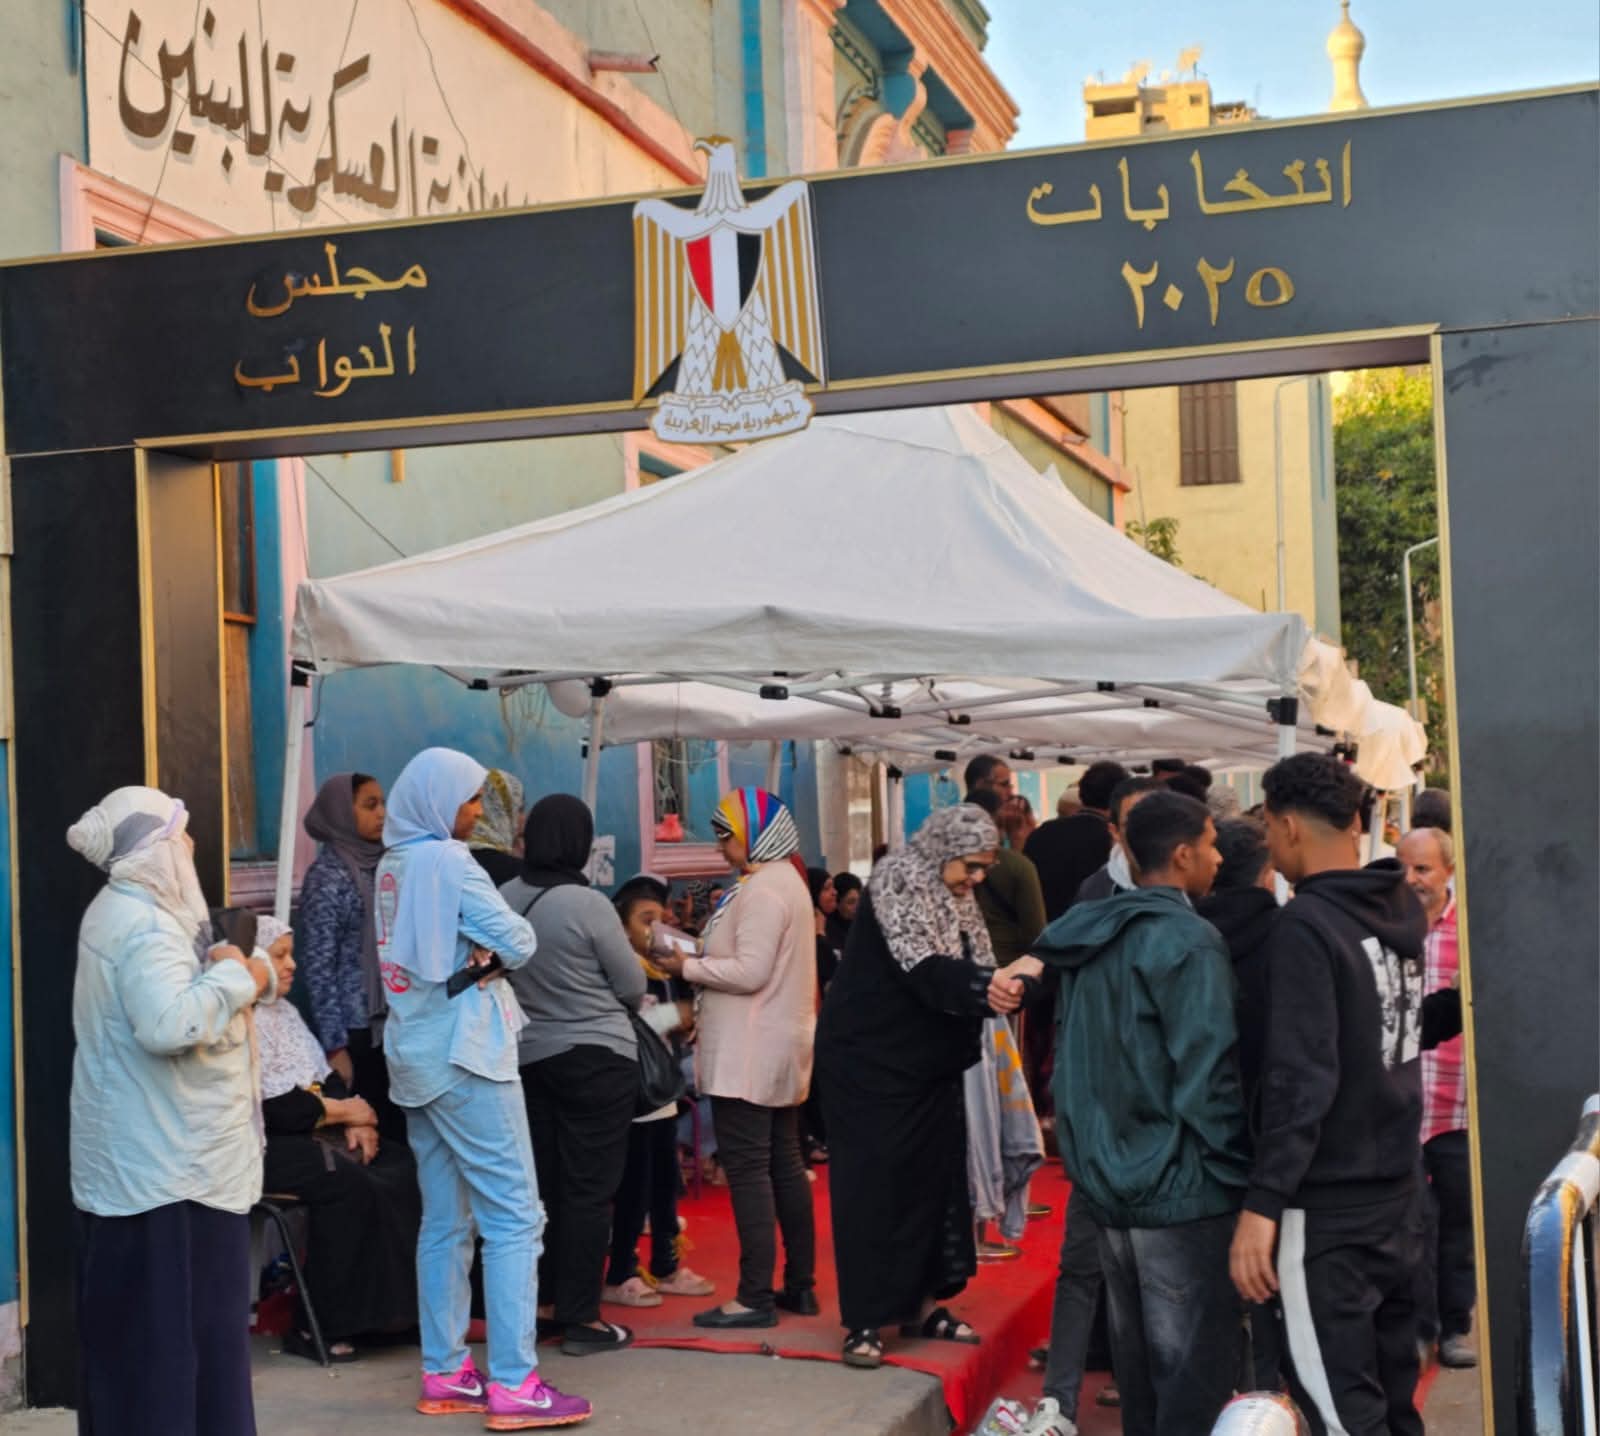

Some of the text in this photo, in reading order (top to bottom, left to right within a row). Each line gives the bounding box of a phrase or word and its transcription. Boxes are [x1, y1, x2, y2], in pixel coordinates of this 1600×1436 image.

[118, 8, 270, 173] للبنين
[265, 53, 418, 216] العسكرية
[1027, 139, 1352, 231] انتخابات
[246, 241, 428, 317] مجلس
[1121, 256, 1295, 329] ٢٠٢٥
[234, 321, 416, 398] النواب
